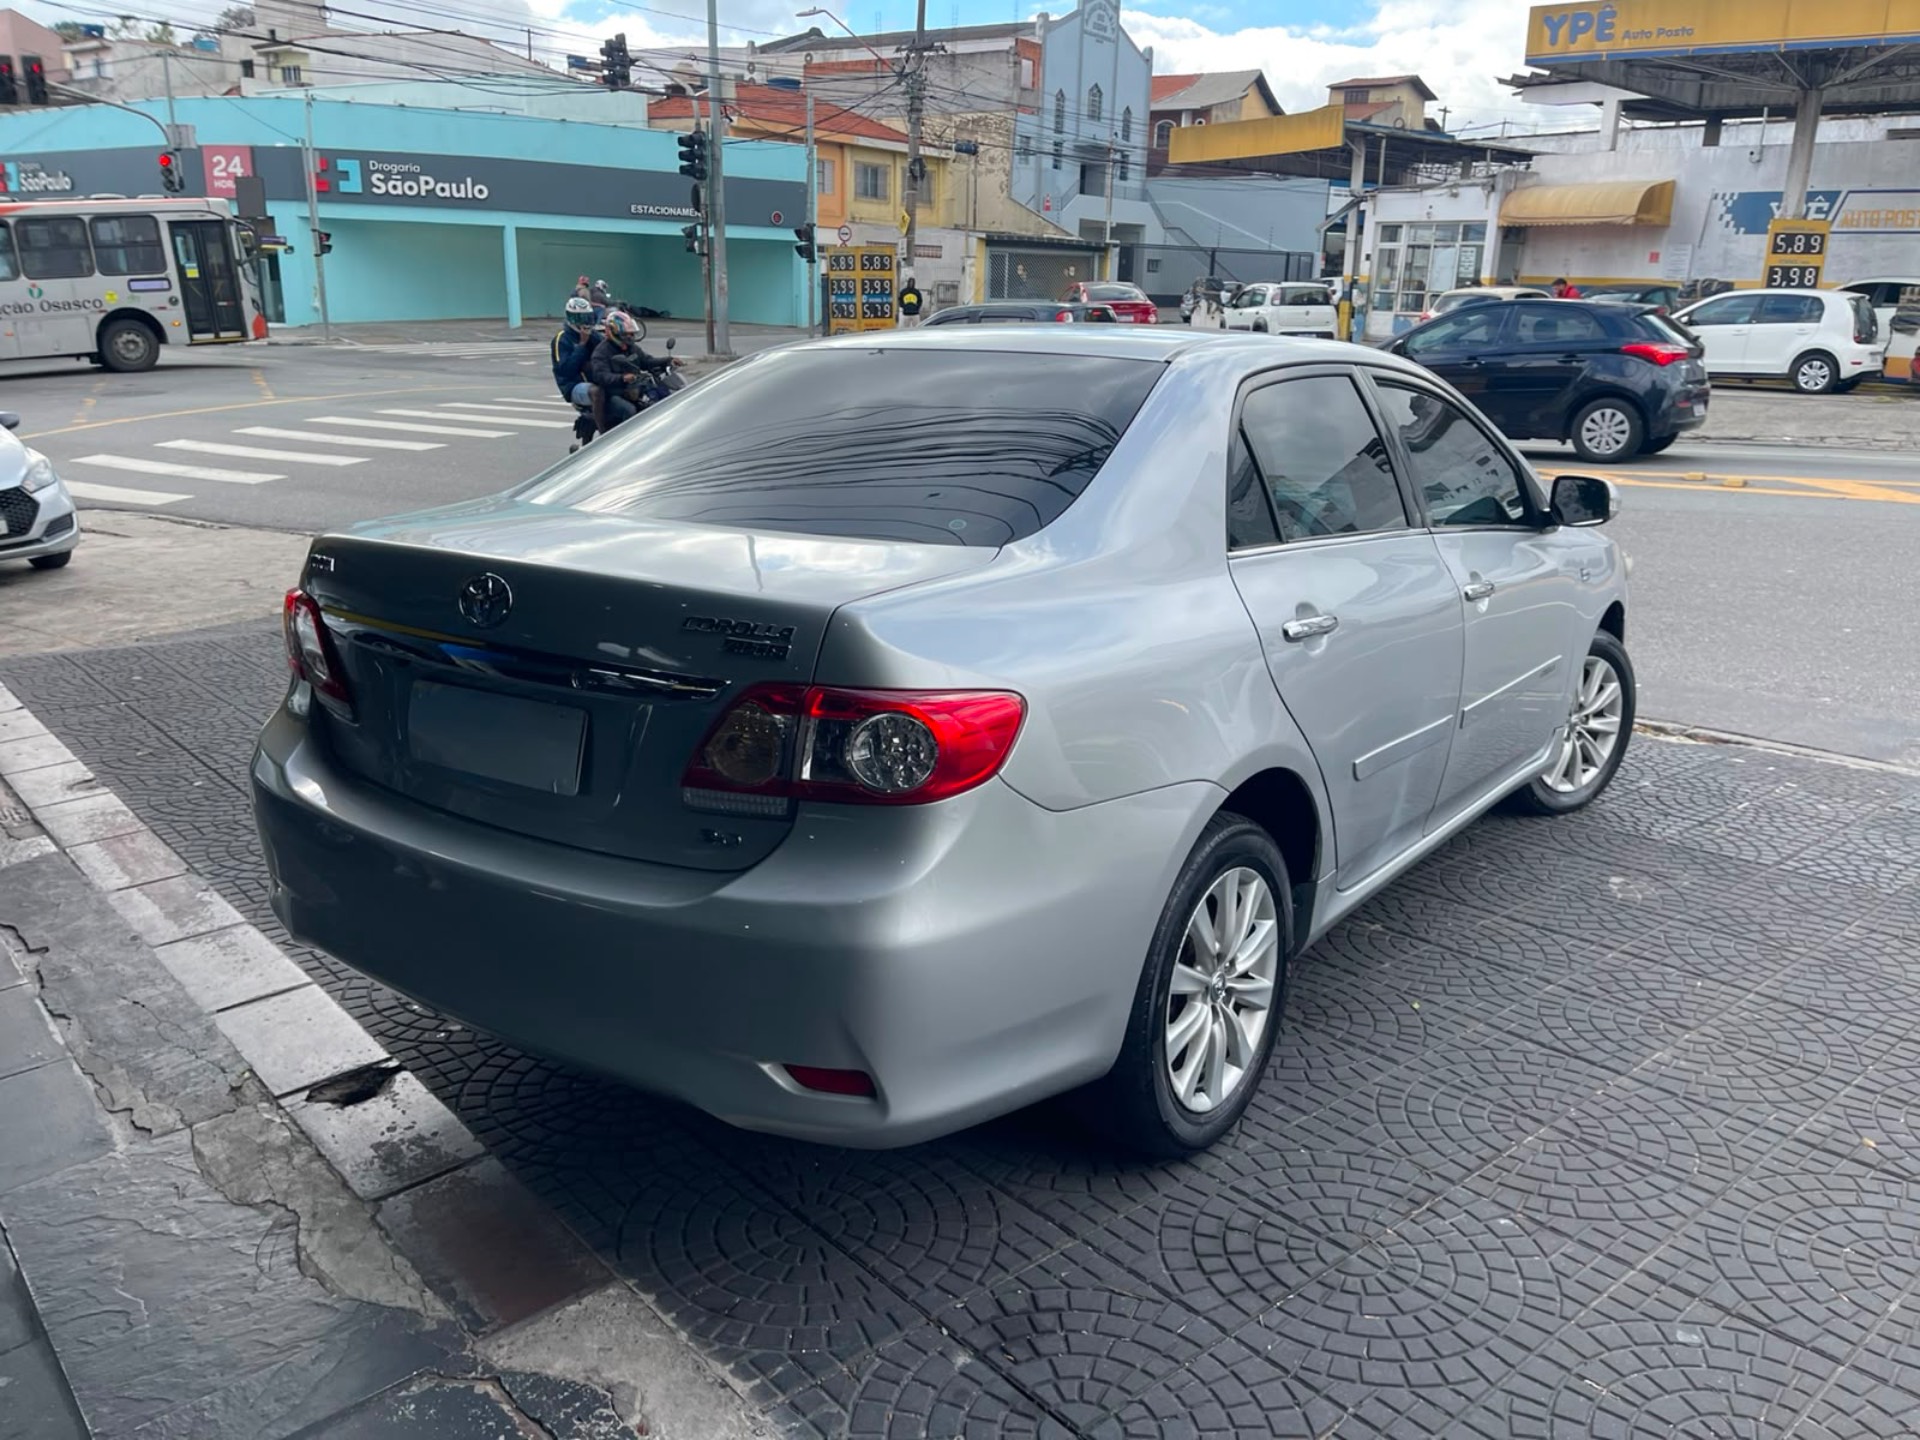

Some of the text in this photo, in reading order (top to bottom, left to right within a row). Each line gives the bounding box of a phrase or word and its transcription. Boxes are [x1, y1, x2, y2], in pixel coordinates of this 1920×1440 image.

[1543, 4, 1695, 46] YPÊ Auto Posto
[212, 155, 244, 177] 24
[368, 160, 420, 173] Drogaria
[213, 180, 237, 189] HOR
[371, 173, 489, 199] SãoPaulo
[630, 204, 703, 217] ESTACIONAMEN
[1776, 234, 1822, 254] 5,89
[831, 256, 854, 270] 5,89
[862, 256, 890, 270] 5,89
[1771, 267, 1816, 287] 3,98
[832, 280, 855, 294] 3,99
[864, 280, 890, 294] 3,99
[39, 298, 103, 312] Osasco
[832, 303, 855, 317] 5,79
[863, 303, 890, 317] 5,79
[683, 616, 797, 638] COROLLA
